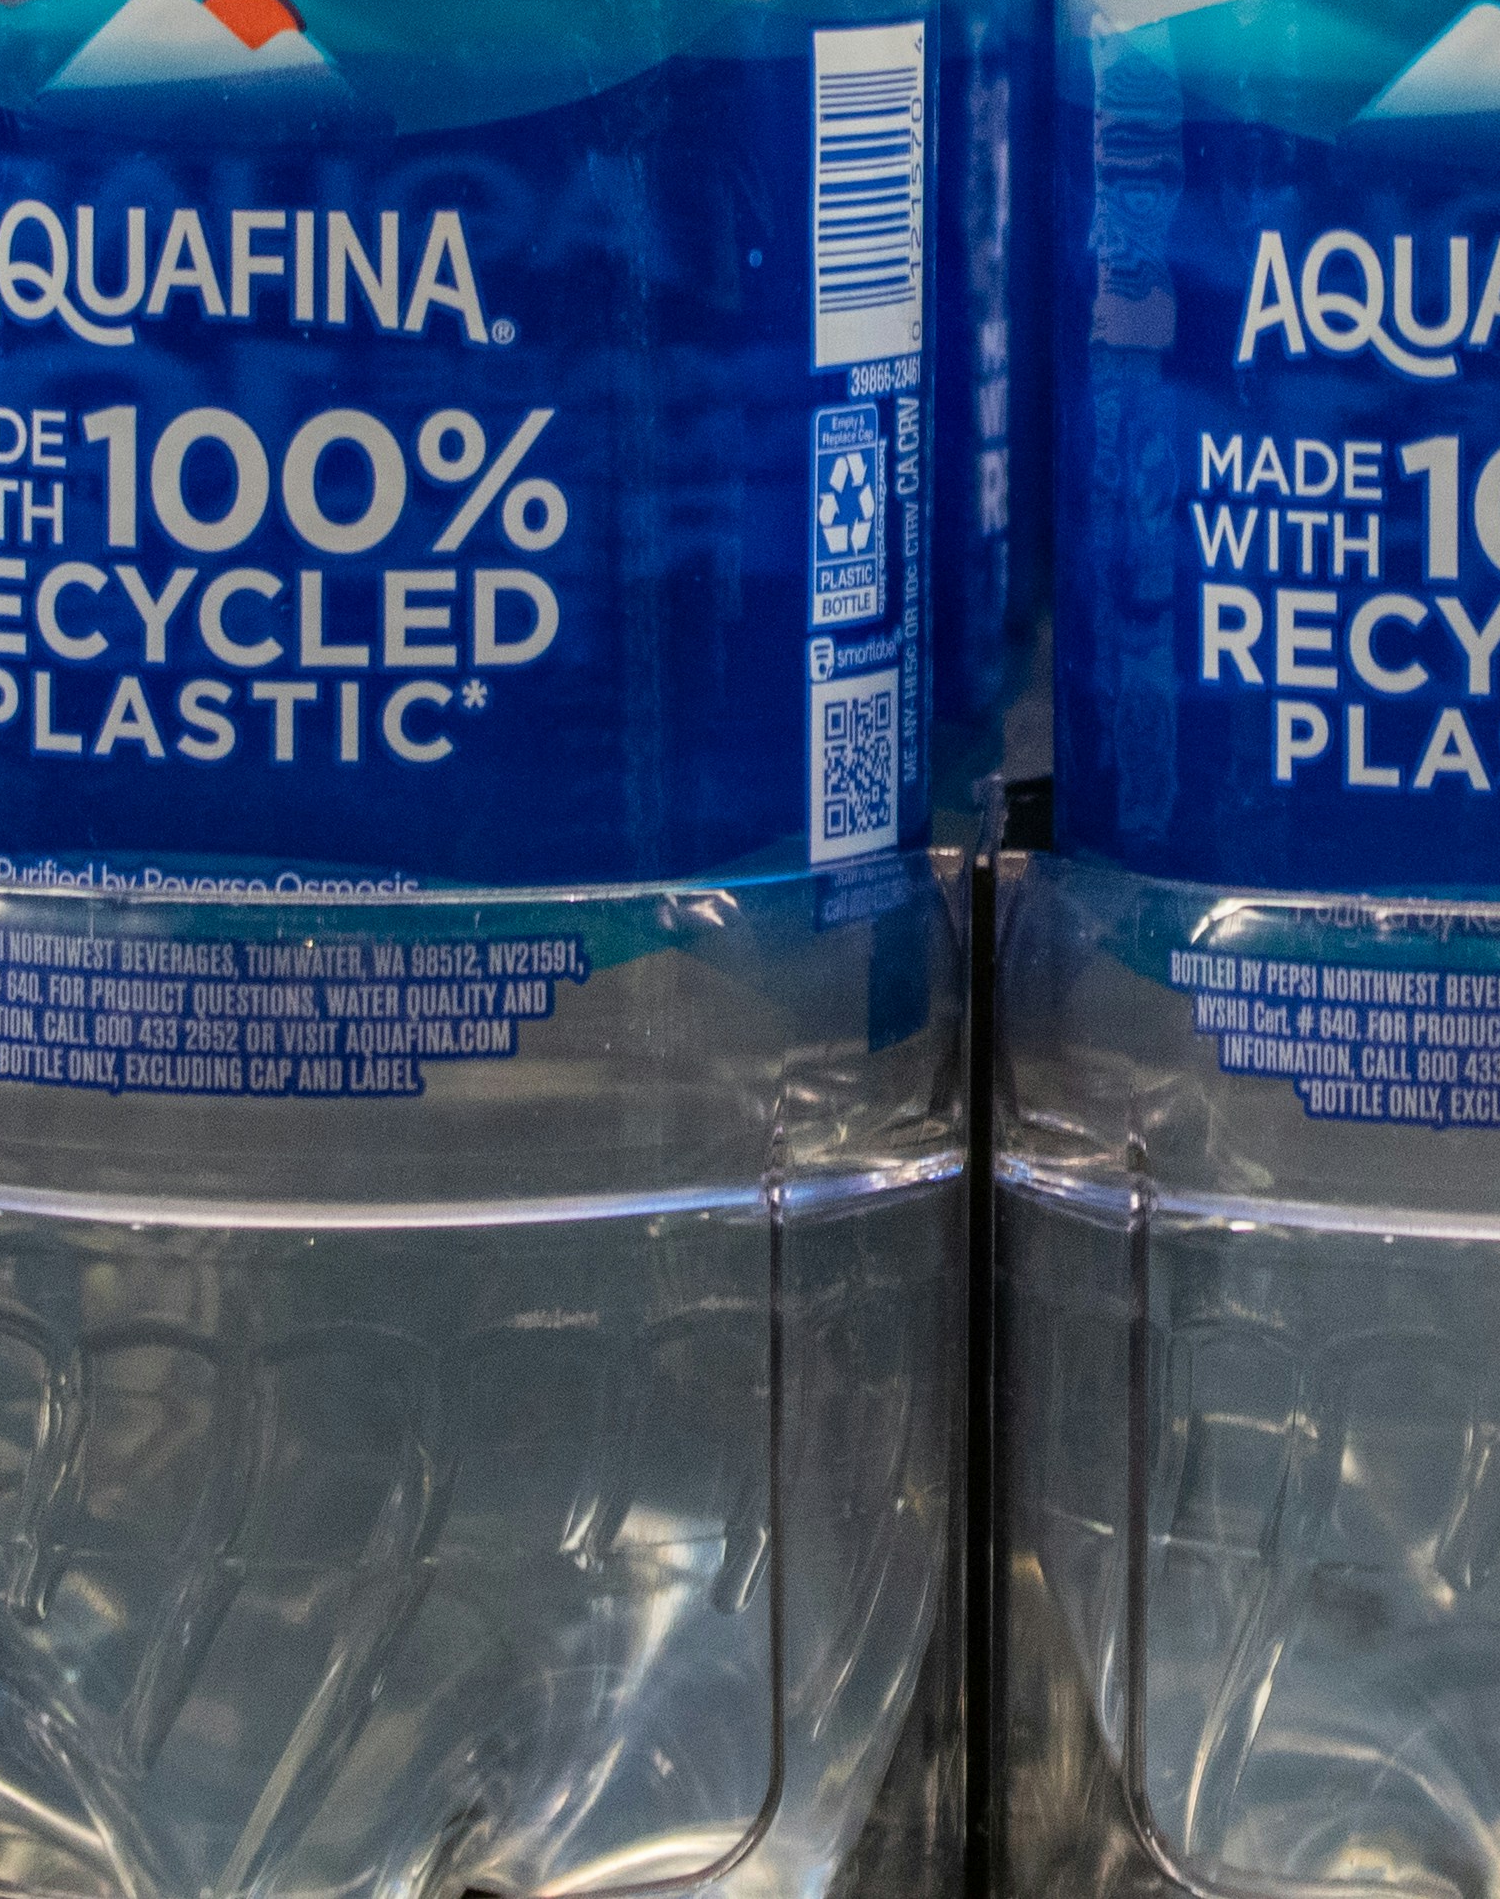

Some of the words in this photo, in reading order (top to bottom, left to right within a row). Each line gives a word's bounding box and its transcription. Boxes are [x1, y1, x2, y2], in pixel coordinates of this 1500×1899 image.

[897, 396, 920, 453] CRV
[83, 406, 568, 554] 100%
[896, 453, 920, 495] CA
[1201, 433, 1382, 500] MADE
[1193, 504, 1380, 576] WITH
[820, 564, 874, 591] PLASTIC
[821, 591, 872, 618] BOTTLE
[10, 931, 114, 972] NORTHWEST
[121, 938, 239, 979] BEVERAGES,
[373, 946, 405, 979] WA
[489, 939, 585, 978] NV21591,
[1171, 951, 1235, 990] BOTTLED
[1241, 958, 1262, 992] BY
[1267, 961, 1317, 998] PEPSI
[1323, 967, 1439, 1006] NORTHWEST
[50, 974, 86, 1008] FOR
[92, 977, 187, 1015] PRODUCT
[193, 981, 321, 1020] QUESTIONS,
[325, 984, 400, 1018] WATER
[406, 984, 498, 1022] QUALITY
[503, 981, 547, 1015] AND
[1197, 995, 1248, 1031] NYSHD
[1299, 1005, 1314, 1038] #
[1319, 1007, 1362, 1041] 640.
[1367, 1010, 1407, 1043] FOR
[43, 1011, 89, 1046] CALL
[139, 1017, 177, 1051] 433
[186, 1020, 239, 1052] 2652
[246, 1020, 276, 1054] OR
[280, 1021, 340, 1054] VISIT
[346, 1020, 512, 1058] AQUAFINA.COM
[125, 1054, 242, 1091] EXCLUDING
[249, 1059, 293, 1091] CAP
[299, 1059, 343, 1092] AND
[350, 1057, 419, 1092] LABEL
[1223, 1034, 1355, 1081] INFORMATION,
[1361, 1047, 1411, 1081] CALL
[1417, 1051, 1457, 1084] 800
[1389, 1083, 1445, 1123] ONLY,
